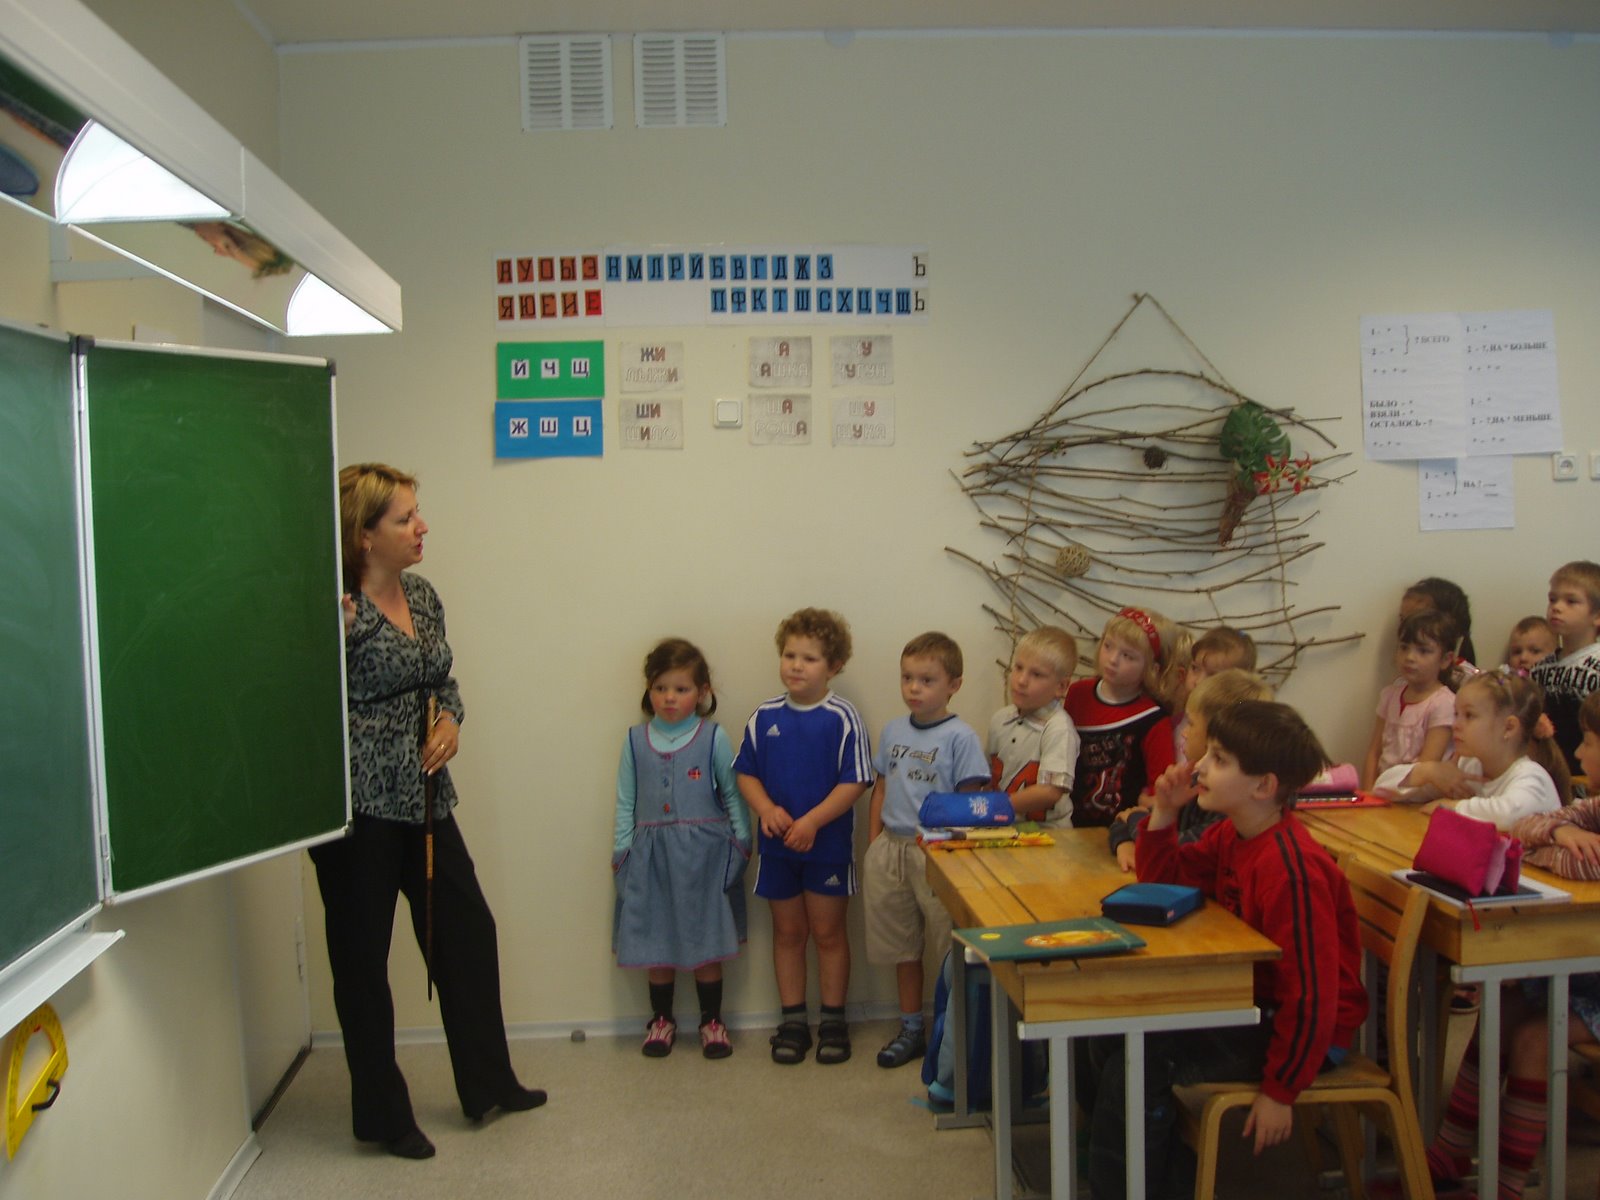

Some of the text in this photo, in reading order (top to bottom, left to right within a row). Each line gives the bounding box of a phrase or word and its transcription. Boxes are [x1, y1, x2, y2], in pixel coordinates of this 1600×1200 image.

[518, 258, 533, 282] У
[540, 258, 554, 280] О
[560, 257, 576, 280] Ы
[583, 256, 597, 279] Э
[607, 256, 620, 278] Н
[628, 257, 642, 279] М
[670, 256, 682, 278] Р
[711, 257, 723, 279] Б
[734, 258, 744, 279] В
[753, 258, 764, 279] Г
[775, 256, 788, 280] Д
[796, 257, 810, 280] Ж
[820, 256, 831, 279] З
[501, 297, 513, 318] Я
[519, 294, 536, 317] Ю
[563, 293, 578, 315] И
[712, 289, 726, 311] П
[731, 291, 746, 311] Ф
[752, 289, 766, 311] К
[774, 289, 787, 311] Т
[796, 289, 810, 311] Ш
[819, 289, 831, 311] С
[837, 289, 852, 312] Х
[858, 289, 872, 313] Ц
[877, 292, 890, 313] Ч
[640, 346, 666, 362] ЖИ
[514, 359, 590, 378] Й Ч Щ
[636, 403, 661, 419] ШИ
[511, 420, 590, 435] Ж Ш Ц
[892, 744, 911, 759] 57
